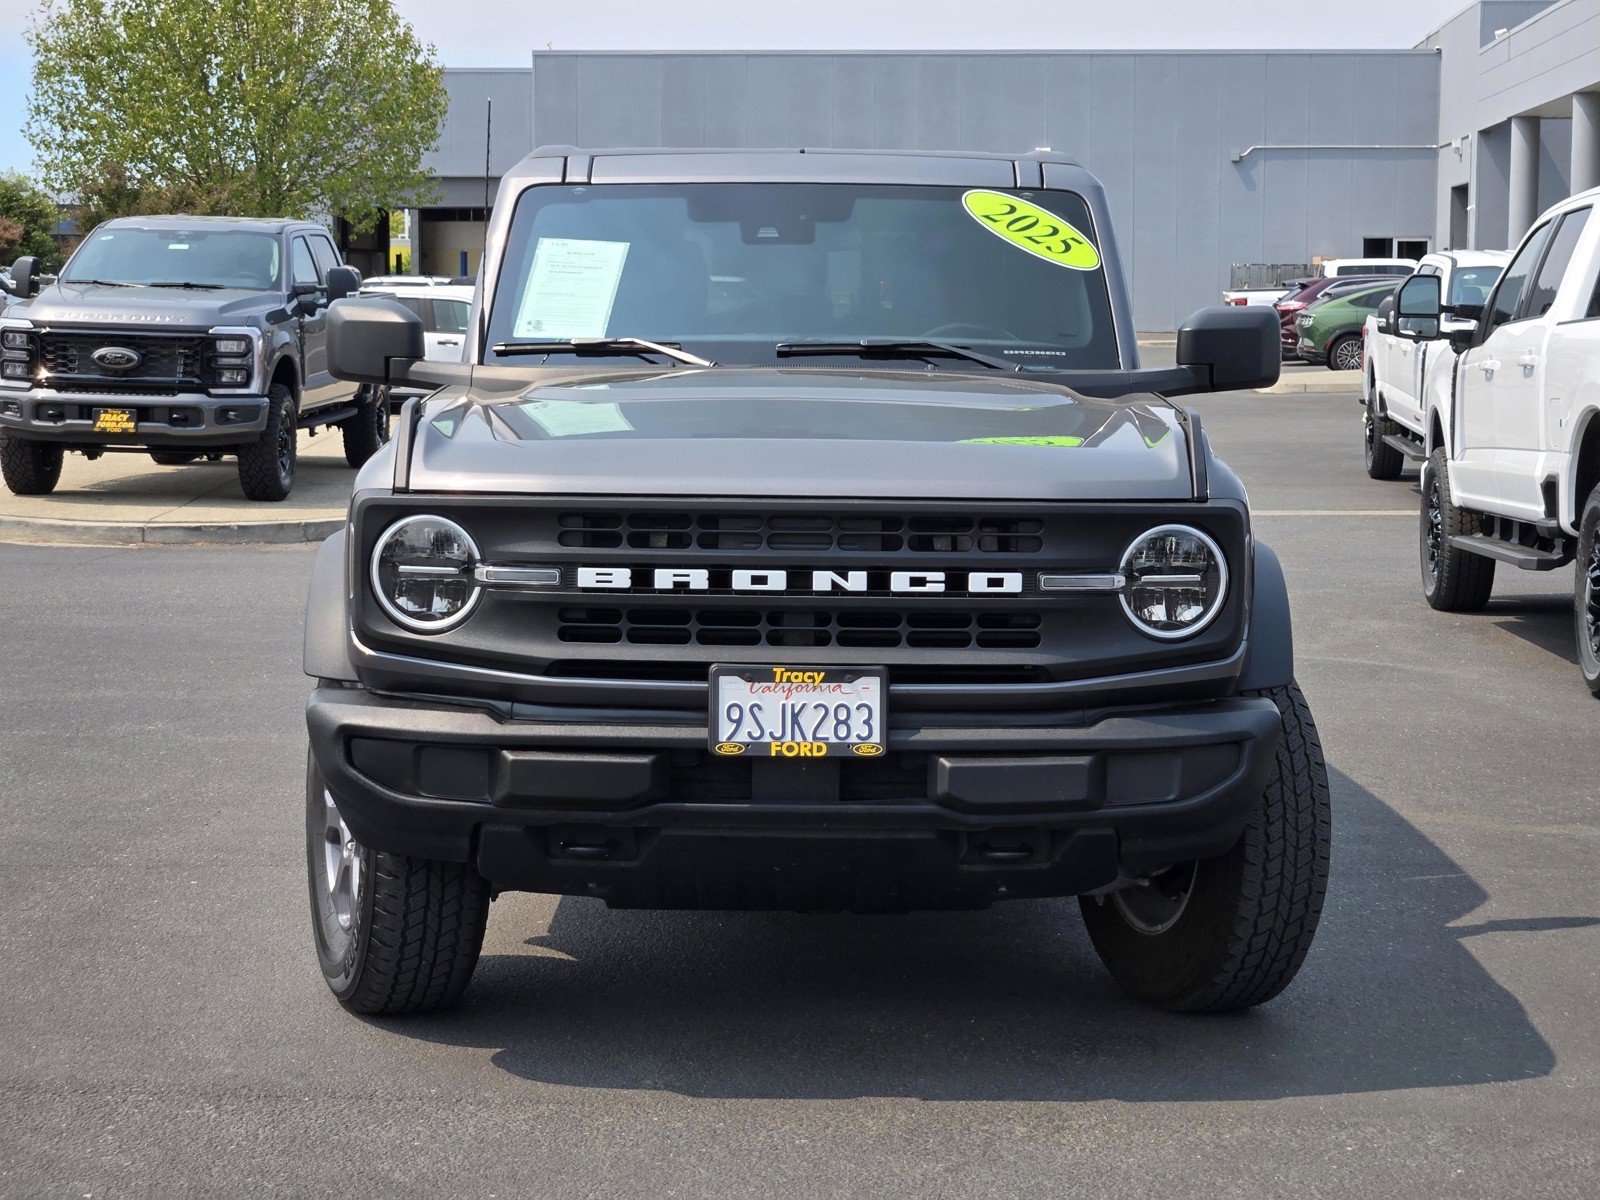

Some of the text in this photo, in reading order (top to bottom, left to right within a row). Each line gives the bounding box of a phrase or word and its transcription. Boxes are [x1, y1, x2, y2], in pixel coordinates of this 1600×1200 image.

[980, 203, 1083, 254] 2025
[104, 353, 128, 364] Ford
[577, 567, 1022, 593] BRONCO
[772, 668, 825, 685] Tracy
[749, 682, 854, 700] California
[725, 702, 873, 741] 9SJK283
[720, 743, 740, 753] Ford
[770, 742, 827, 756] FORD
[858, 744, 878, 754] Ford
